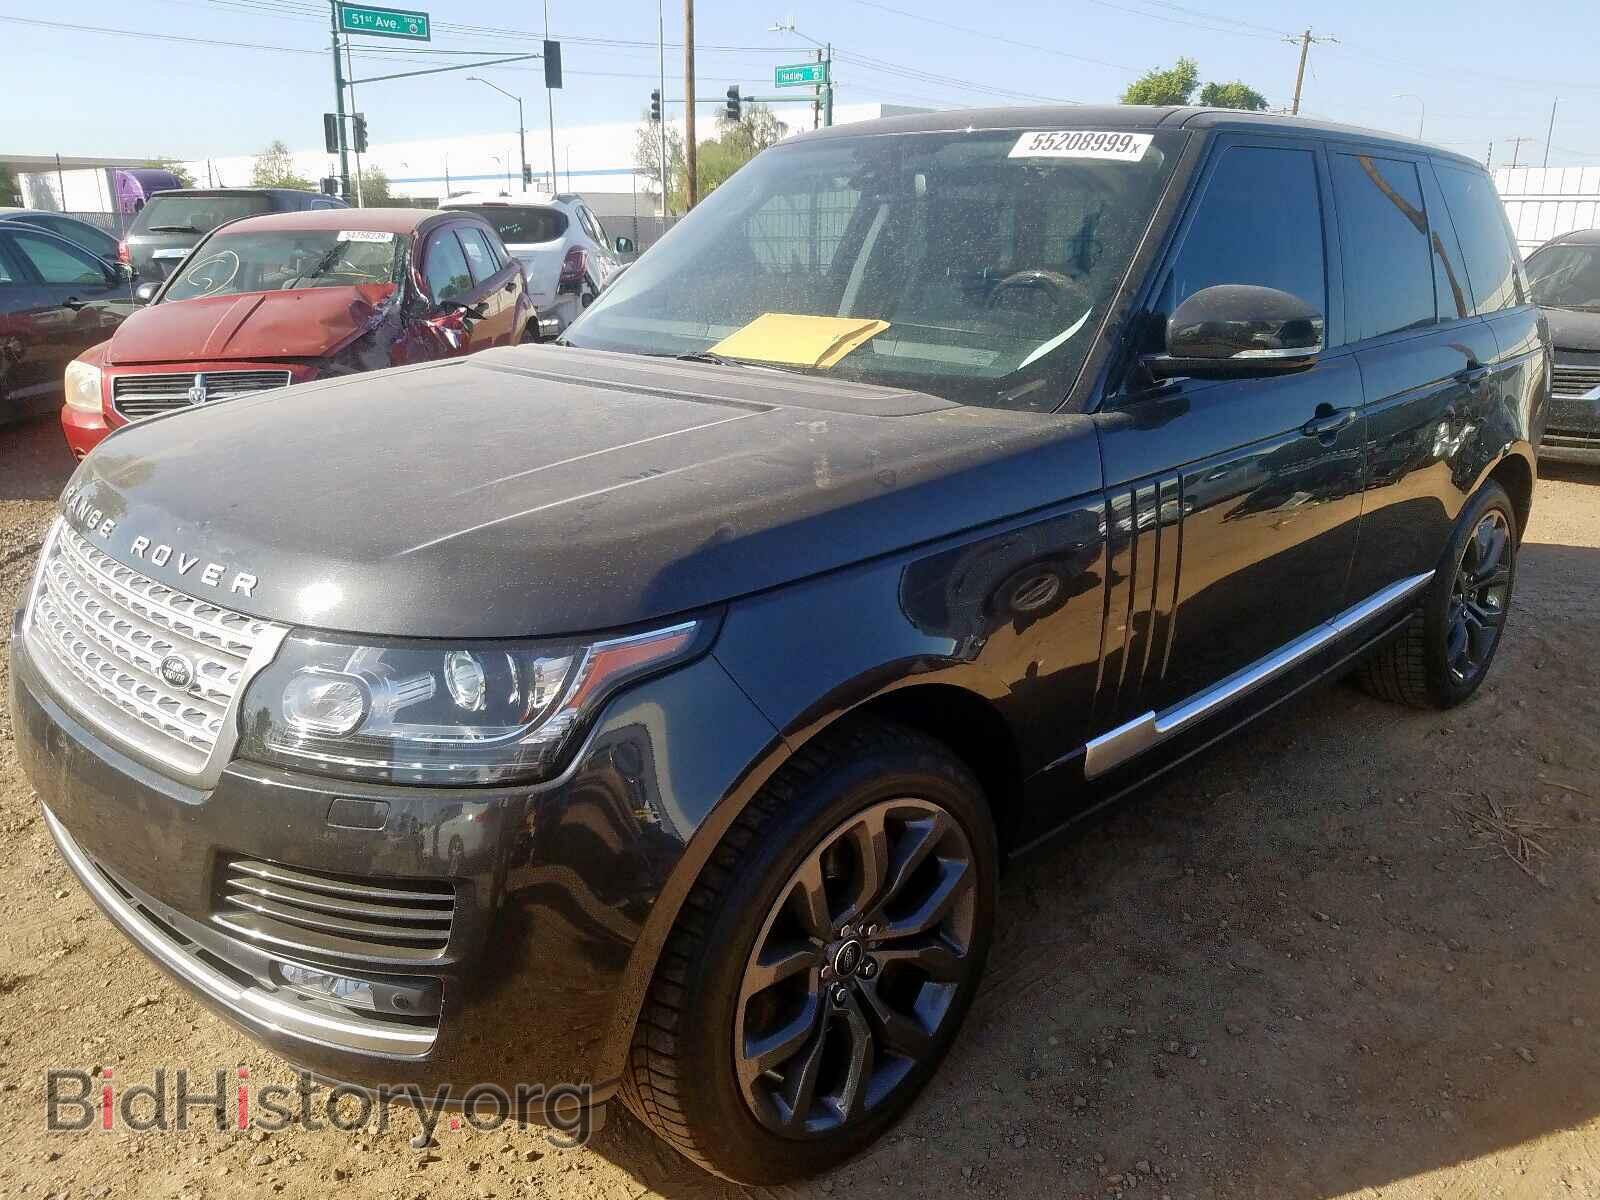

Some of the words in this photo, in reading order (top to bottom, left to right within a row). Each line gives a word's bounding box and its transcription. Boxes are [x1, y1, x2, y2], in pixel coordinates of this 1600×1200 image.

[351, 13, 373, 25] 51st
[64, 487, 118, 539] RANGE
[129, 534, 259, 599] ROVER
